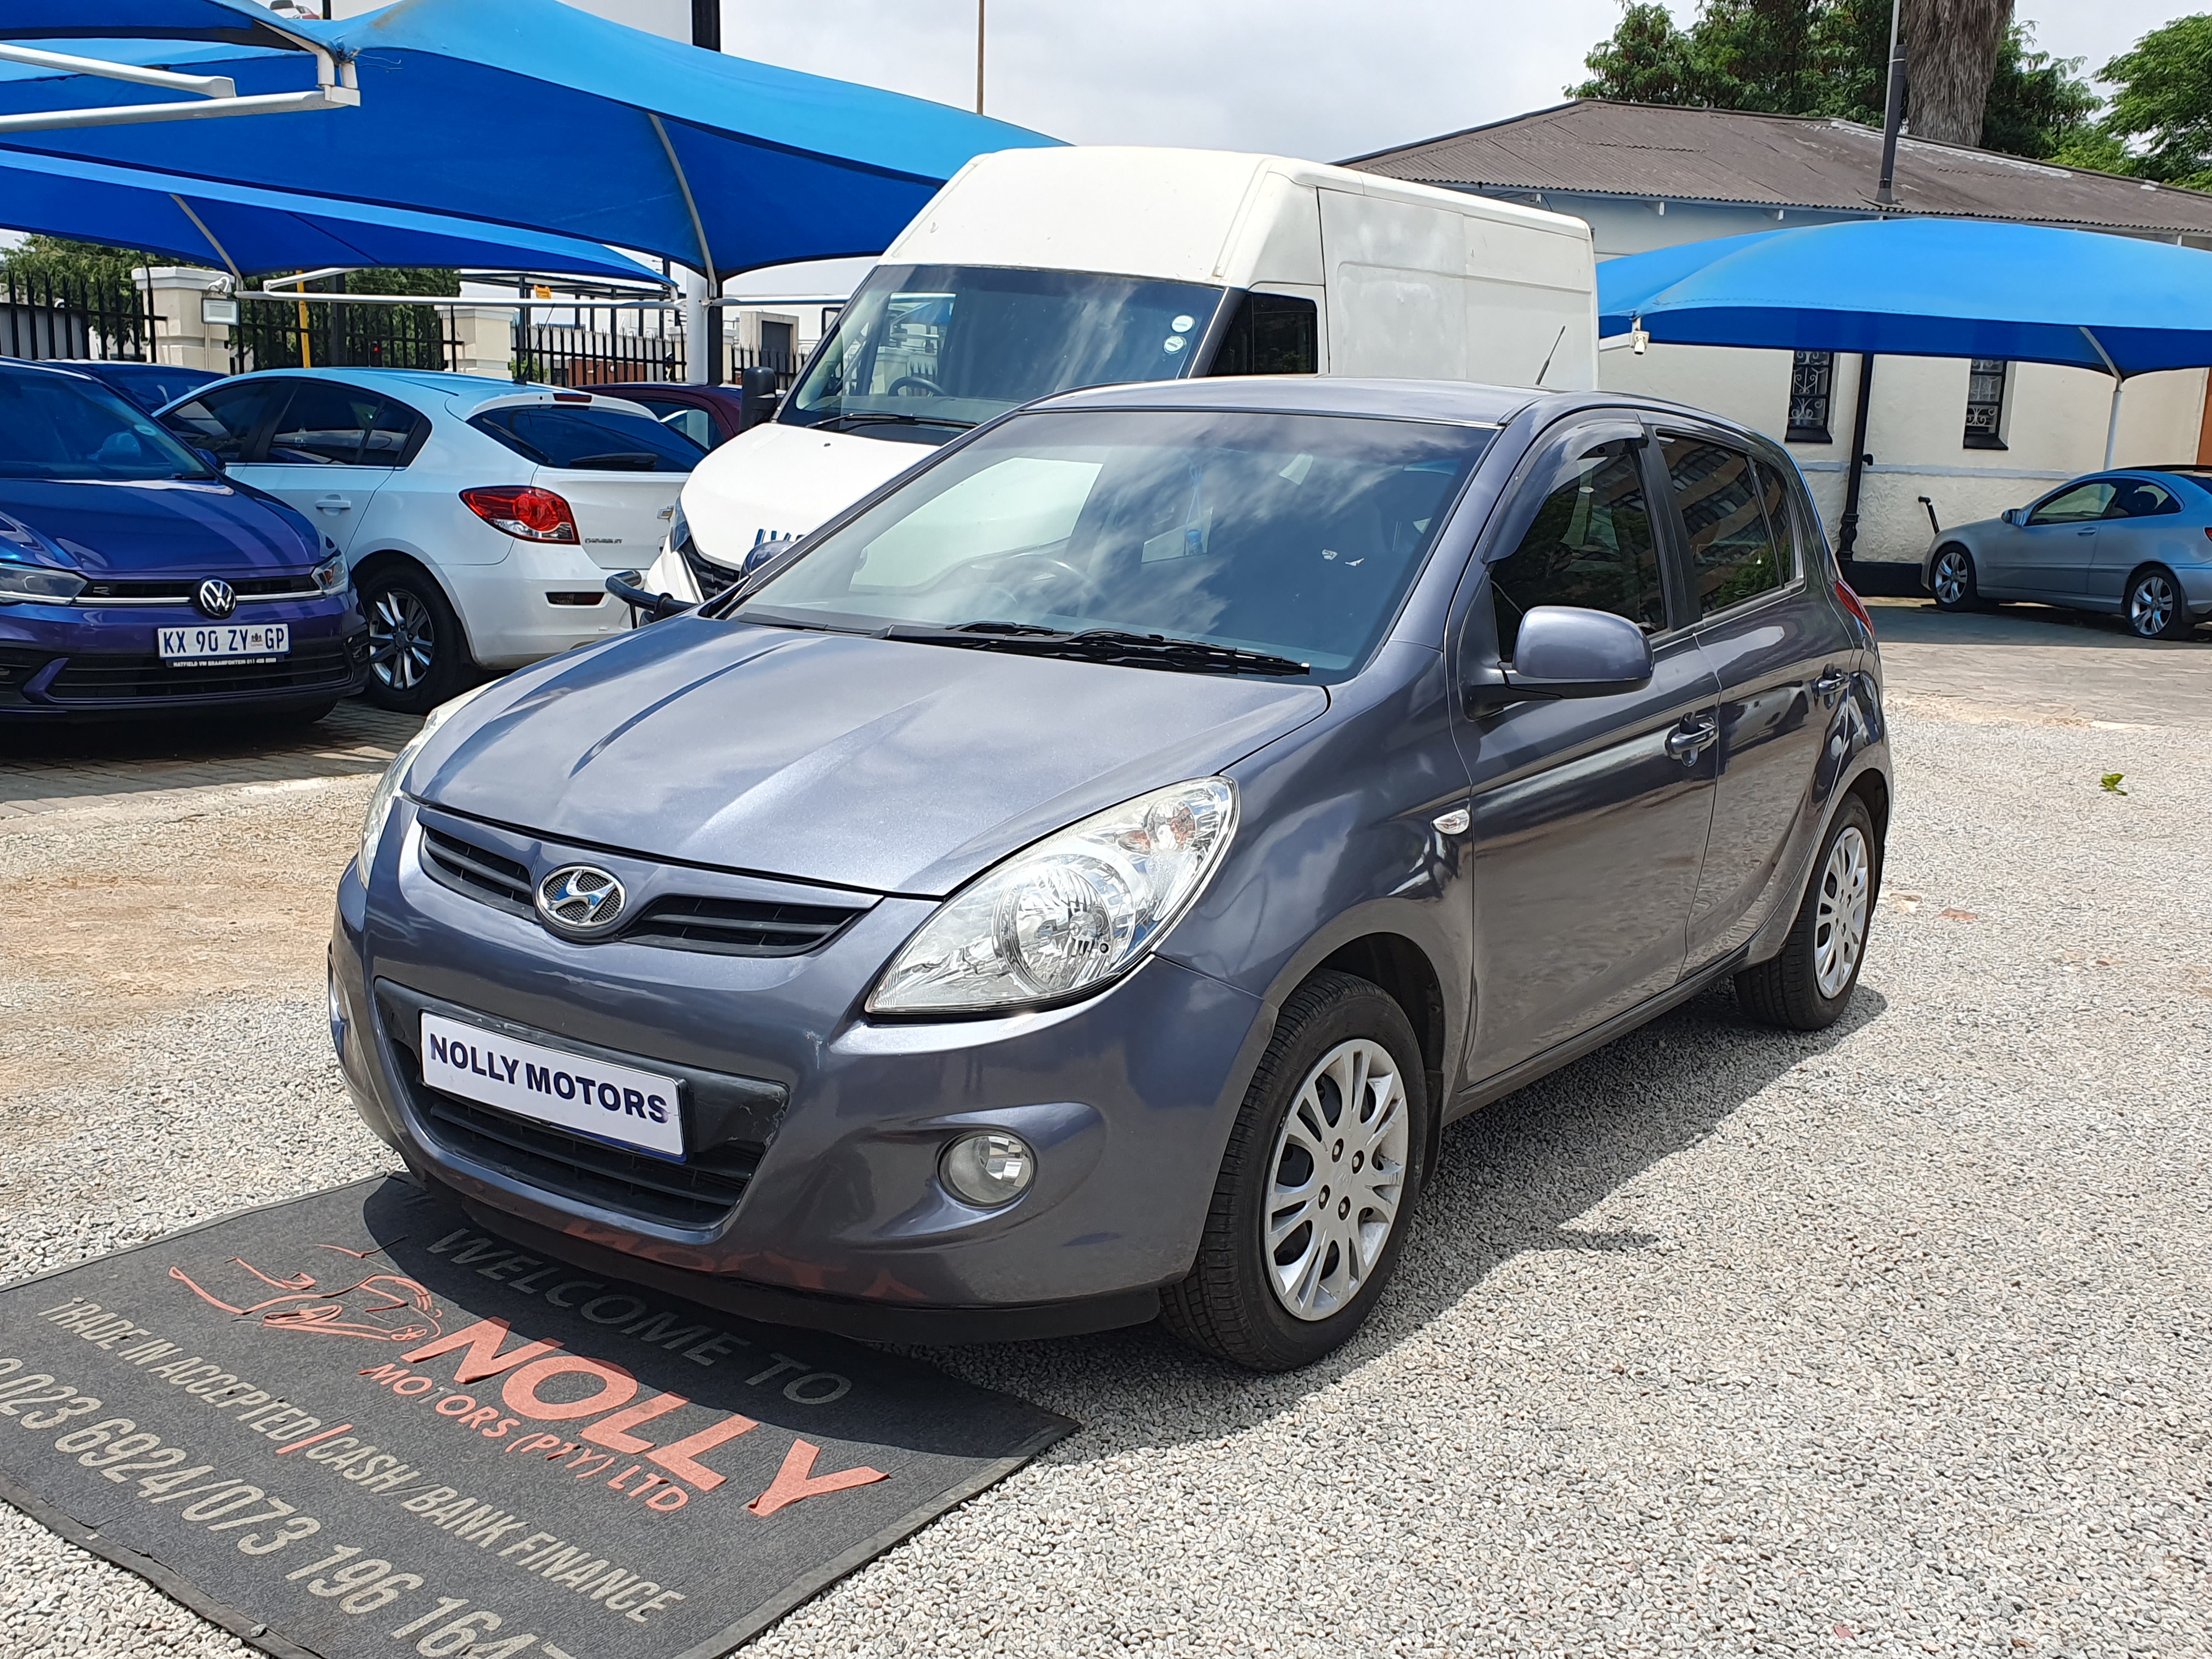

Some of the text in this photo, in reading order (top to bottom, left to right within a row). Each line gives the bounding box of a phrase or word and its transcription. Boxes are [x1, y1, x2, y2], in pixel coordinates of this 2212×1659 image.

[163, 628, 284, 654] KX 90 ZY GP
[430, 1032, 670, 1125] NOLLY MOTORS
[38, 1296, 153, 1350] TRADE
[117, 1338, 184, 1365] IN
[426, 1228, 751, 1366] WELCOME
[745, 1352, 853, 1404] TO
[148, 1357, 321, 1441] ACCEPTED
[358, 1363, 689, 1512] MOTORS (PTY) LTD
[400, 1317, 890, 1516] NOLLY
[285, 1544, 425, 1615] 196
[498, 1531, 686, 1623] FINANCE
